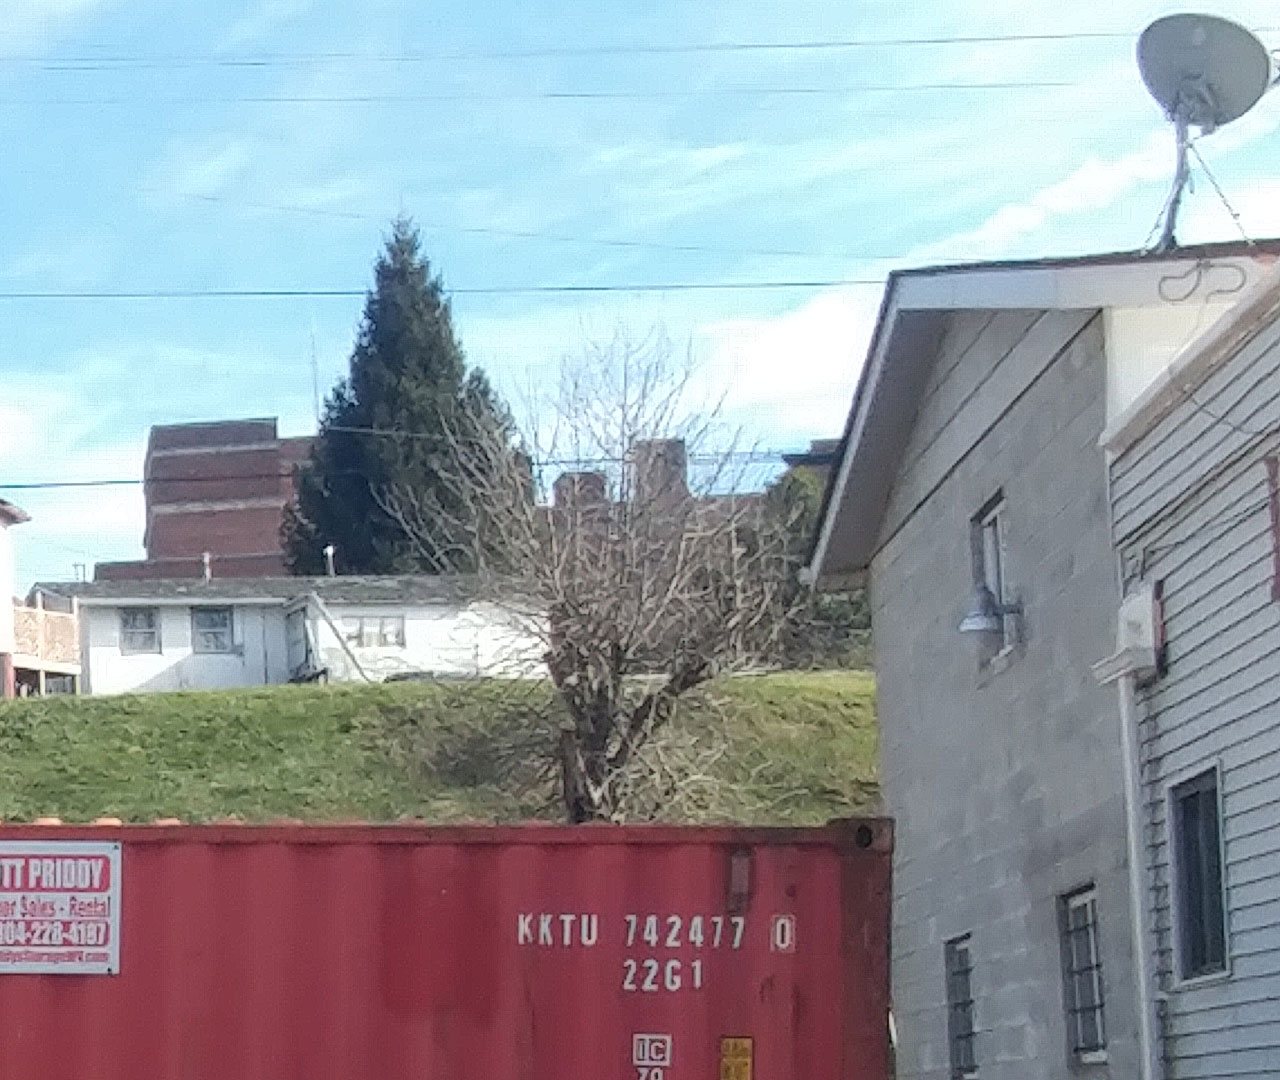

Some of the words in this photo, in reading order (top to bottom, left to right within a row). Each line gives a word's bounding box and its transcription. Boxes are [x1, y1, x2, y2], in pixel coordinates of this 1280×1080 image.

[28, 858, 103, 889] PRIDDY
[19, 894, 56, 917] Sales
[69, 894, 111, 917] Rental
[517, 913, 599, 946] KKTU
[624, 914, 745, 948] 742477
[622, 958, 703, 992] 22G1
